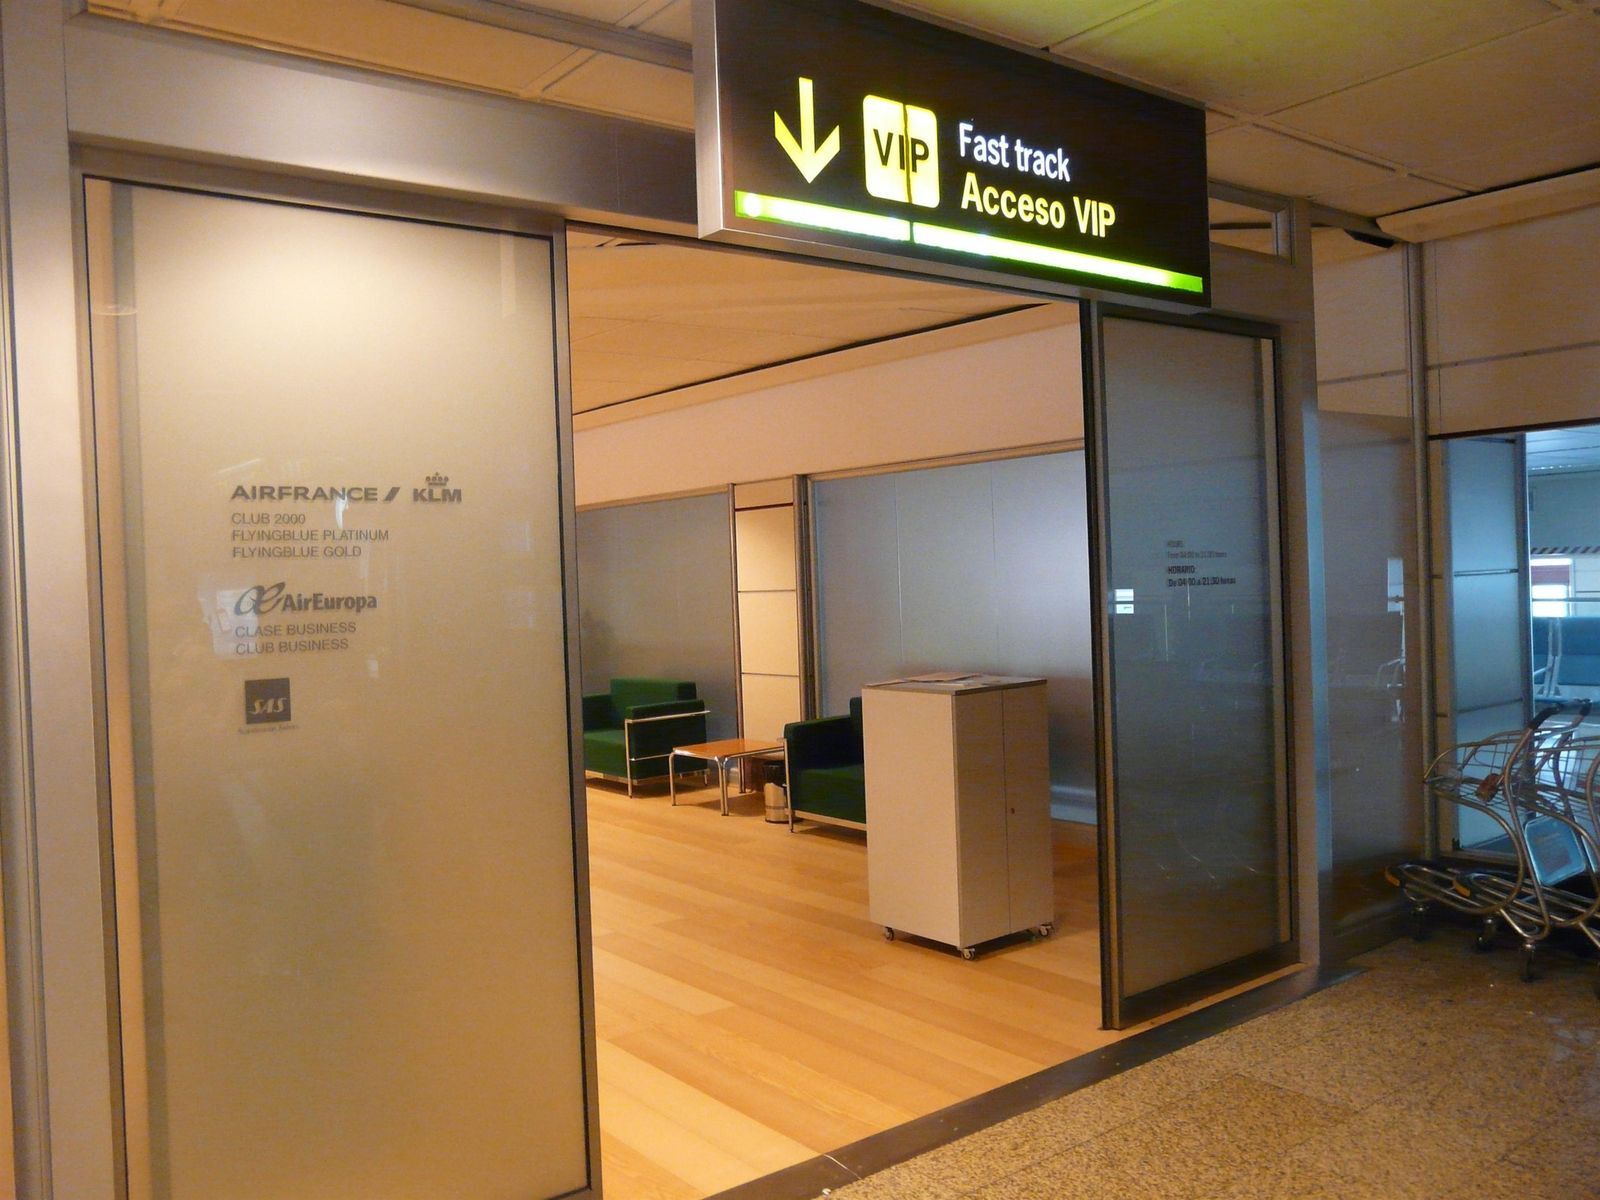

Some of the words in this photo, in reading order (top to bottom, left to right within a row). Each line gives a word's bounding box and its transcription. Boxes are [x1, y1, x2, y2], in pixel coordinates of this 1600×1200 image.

[872, 128, 930, 174] VIP
[958, 122, 1009, 167] Fast
[1015, 138, 1071, 183] track
[961, 172, 1066, 230] Acceso
[1073, 196, 1117, 239] VIP
[231, 485, 378, 501] AIRFRANCE
[412, 488, 462, 503] KLM
[231, 512, 271, 525] CLUB
[274, 513, 306, 524] 2000
[232, 529, 319, 542] FLYINGBLUE
[323, 529, 389, 541] PLATINUM
[232, 546, 319, 558] FLYINGBLUE
[323, 546, 362, 558] GOLD
[235, 624, 283, 639] CLASE
[287, 621, 357, 636] BUSINESS
[235, 642, 275, 656] CLUB
[279, 638, 349, 653] BUSINESS
[249, 697, 288, 715] SAS
